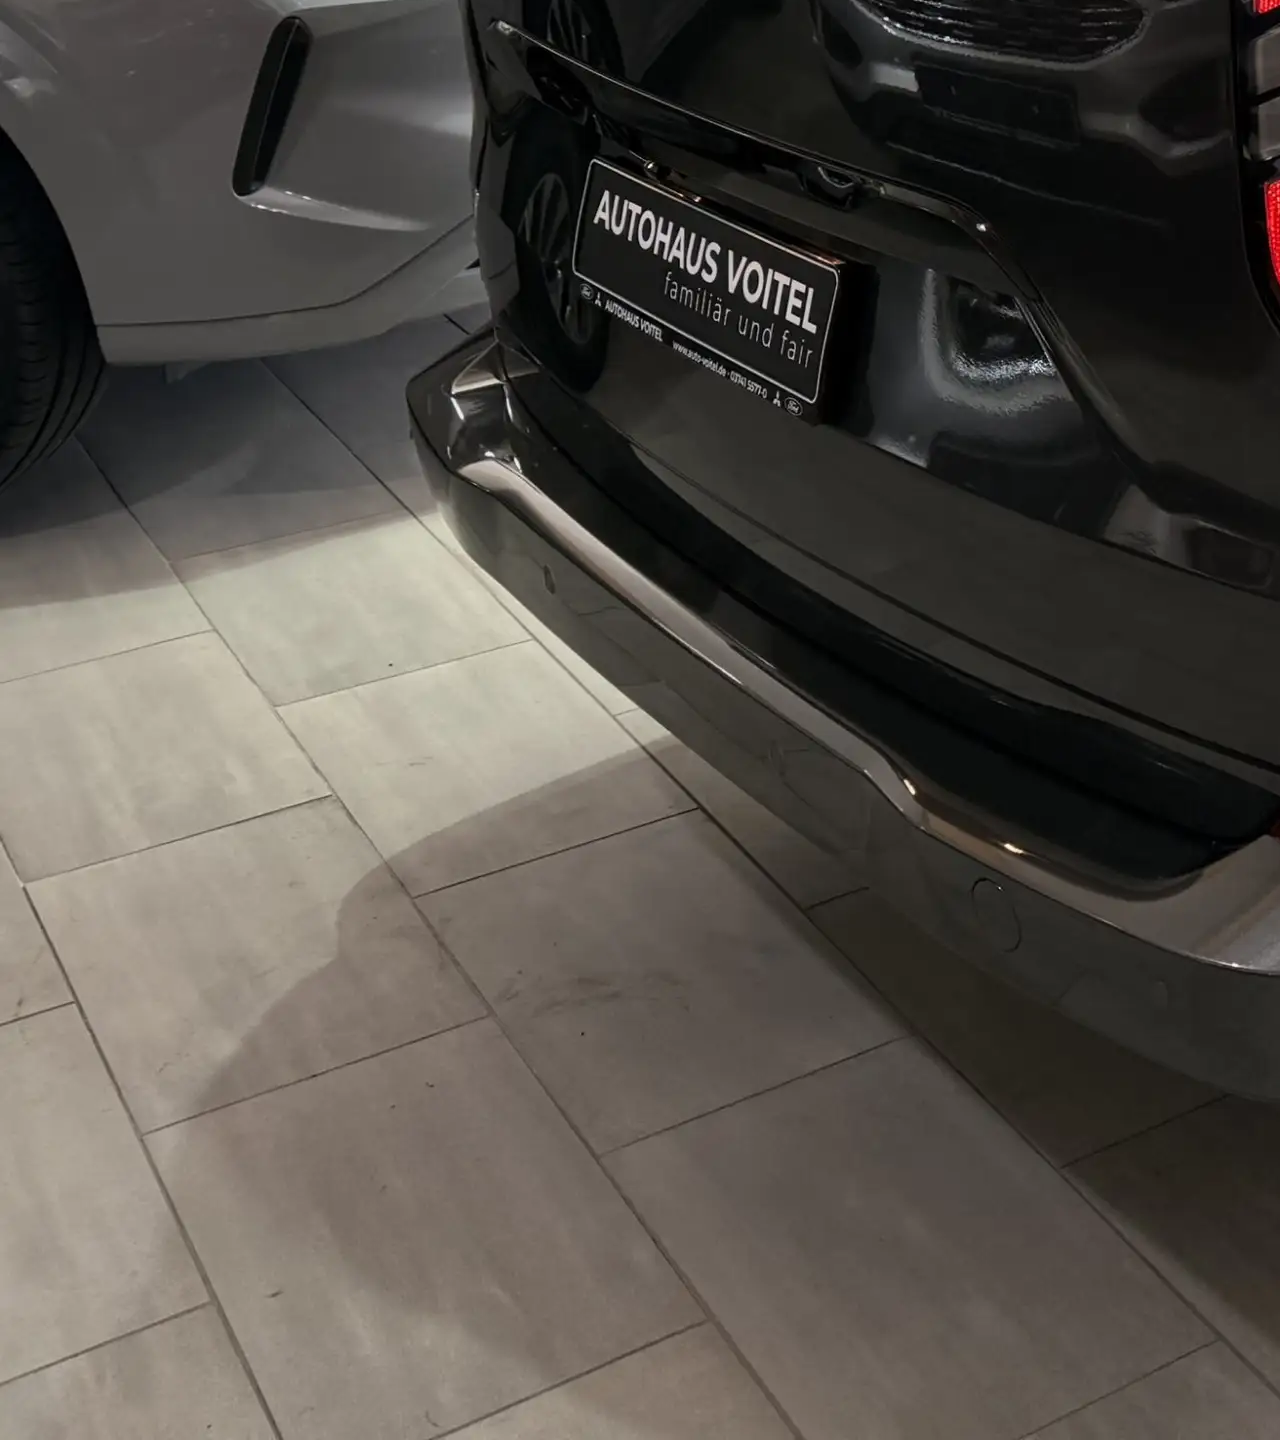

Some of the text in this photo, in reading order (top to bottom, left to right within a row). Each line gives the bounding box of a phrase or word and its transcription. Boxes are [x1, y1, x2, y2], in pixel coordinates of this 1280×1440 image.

[593, 189, 818, 335] AUTOHAUS VOITEL
[604, 299, 641, 329] AUTOHAUS
[640, 320, 663, 343] VOITEL
[663, 271, 814, 369] familiär und fair
